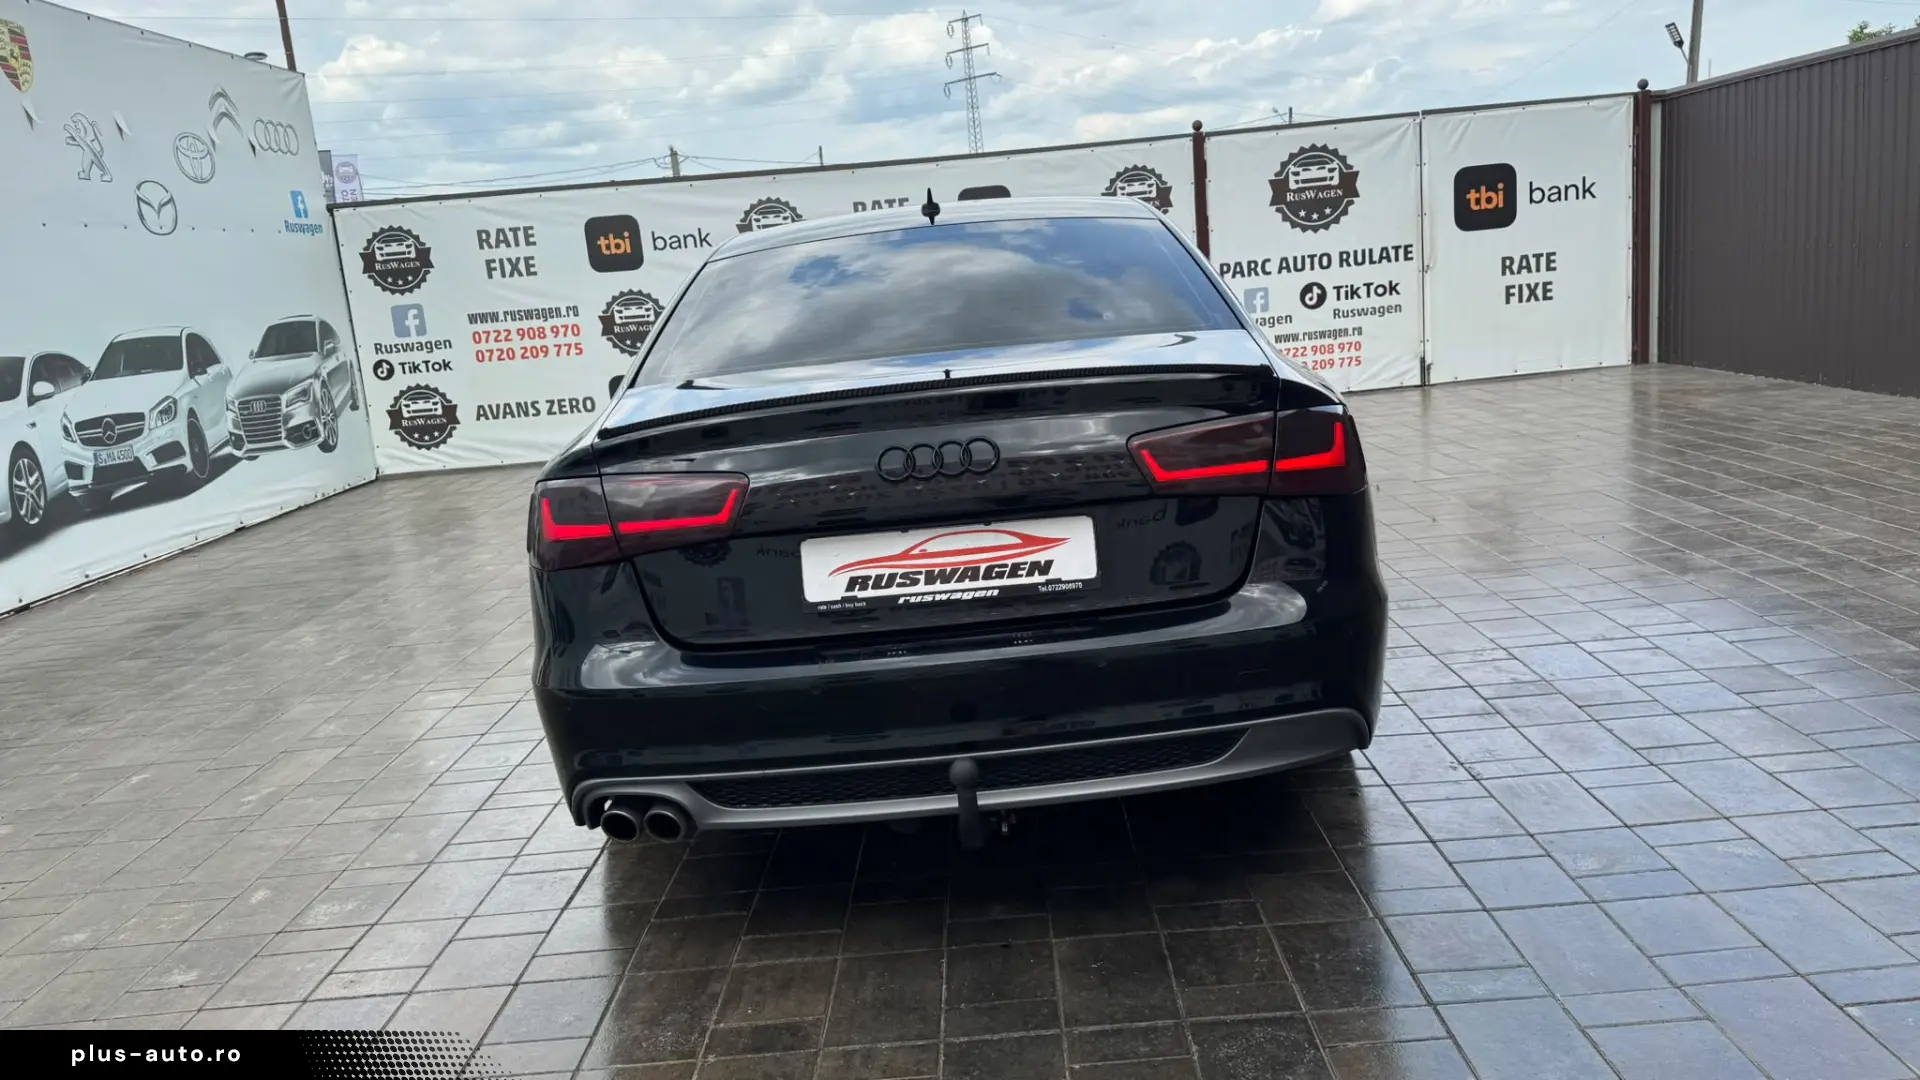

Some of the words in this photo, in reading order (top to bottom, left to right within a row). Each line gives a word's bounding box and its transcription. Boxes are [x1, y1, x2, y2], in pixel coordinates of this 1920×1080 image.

[1466, 182, 1504, 211] tbi
[1529, 176, 1597, 205] bank
[284, 219, 323, 237] Ruswagen
[476, 226, 537, 250] RATE
[597, 231, 633, 255] tbi
[651, 228, 713, 251] bank
[485, 256, 538, 280] FIXE
[1219, 258, 1272, 279] PARC
[1277, 252, 1332, 275] AUTO
[1339, 244, 1414, 268] RULATE
[1501, 251, 1557, 277] RATE
[1332, 281, 1401, 302] TikTok
[1505, 281, 1554, 305] FIXE
[467, 305, 580, 325] www.ruswagen.ro
[1333, 304, 1402, 320] Ruswagen
[472, 329, 513, 345] 0722
[516, 326, 547, 341] 908
[550, 323, 581, 339] 970
[1274, 326, 1363, 344] www.ruswagen.ro
[374, 339, 453, 355] Ruswagen
[475, 347, 516, 363] 0720
[520, 345, 549, 360] 209
[553, 342, 584, 358] 775
[1311, 343, 1335, 356] 908
[1338, 341, 1362, 353] 970
[398, 359, 453, 375] TikTok
[1311, 359, 1335, 371] 209
[1338, 356, 1362, 367] 775
[475, 400, 542, 421] AVANS
[545, 396, 596, 416] ZERO
[844, 559, 1055, 593] RUSWAGEN
[897, 587, 1000, 605] ruswagen
